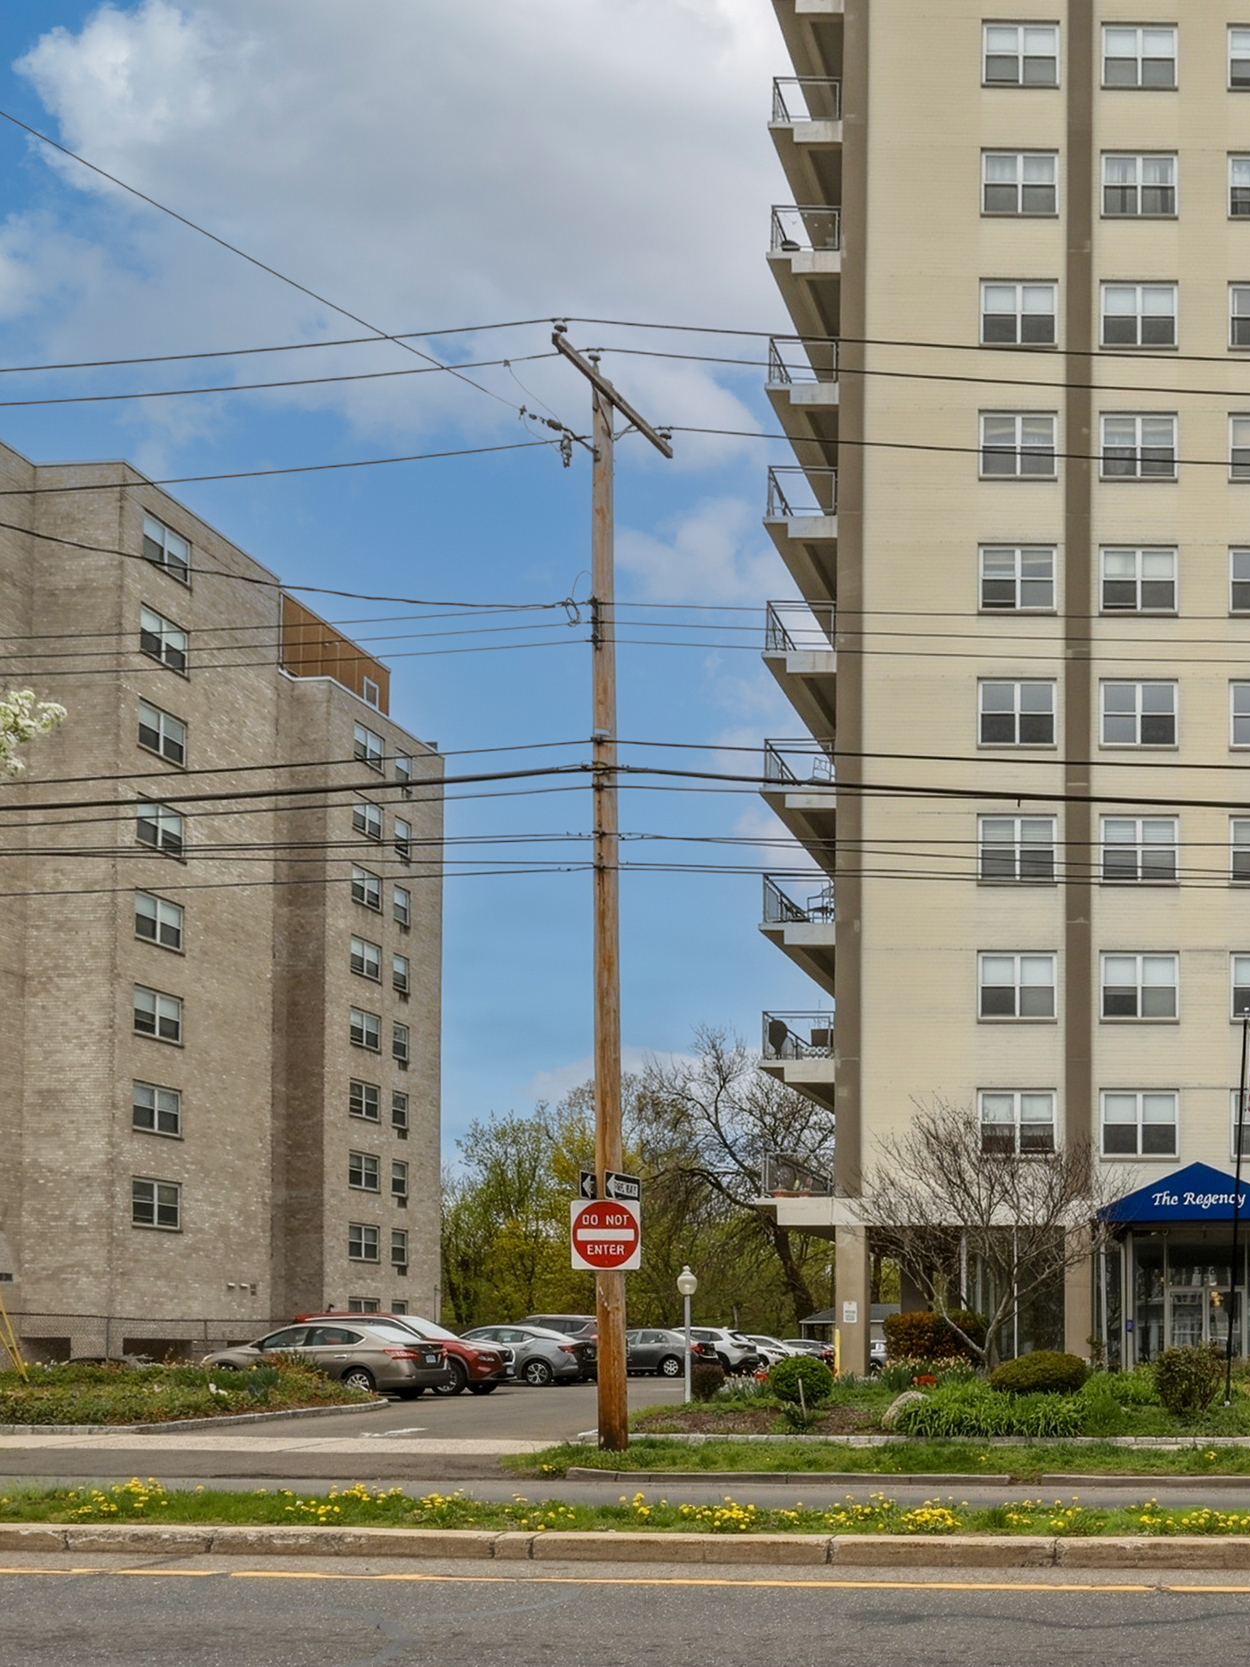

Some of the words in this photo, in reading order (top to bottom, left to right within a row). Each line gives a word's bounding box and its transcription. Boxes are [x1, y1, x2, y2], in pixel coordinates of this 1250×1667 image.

[1151, 1190, 1179, 1206] The
[1183, 1191, 1246, 1209] Regency
[582, 1214, 598, 1225] DO
[605, 1214, 629, 1225] NOT
[586, 1244, 625, 1255] ENTER
